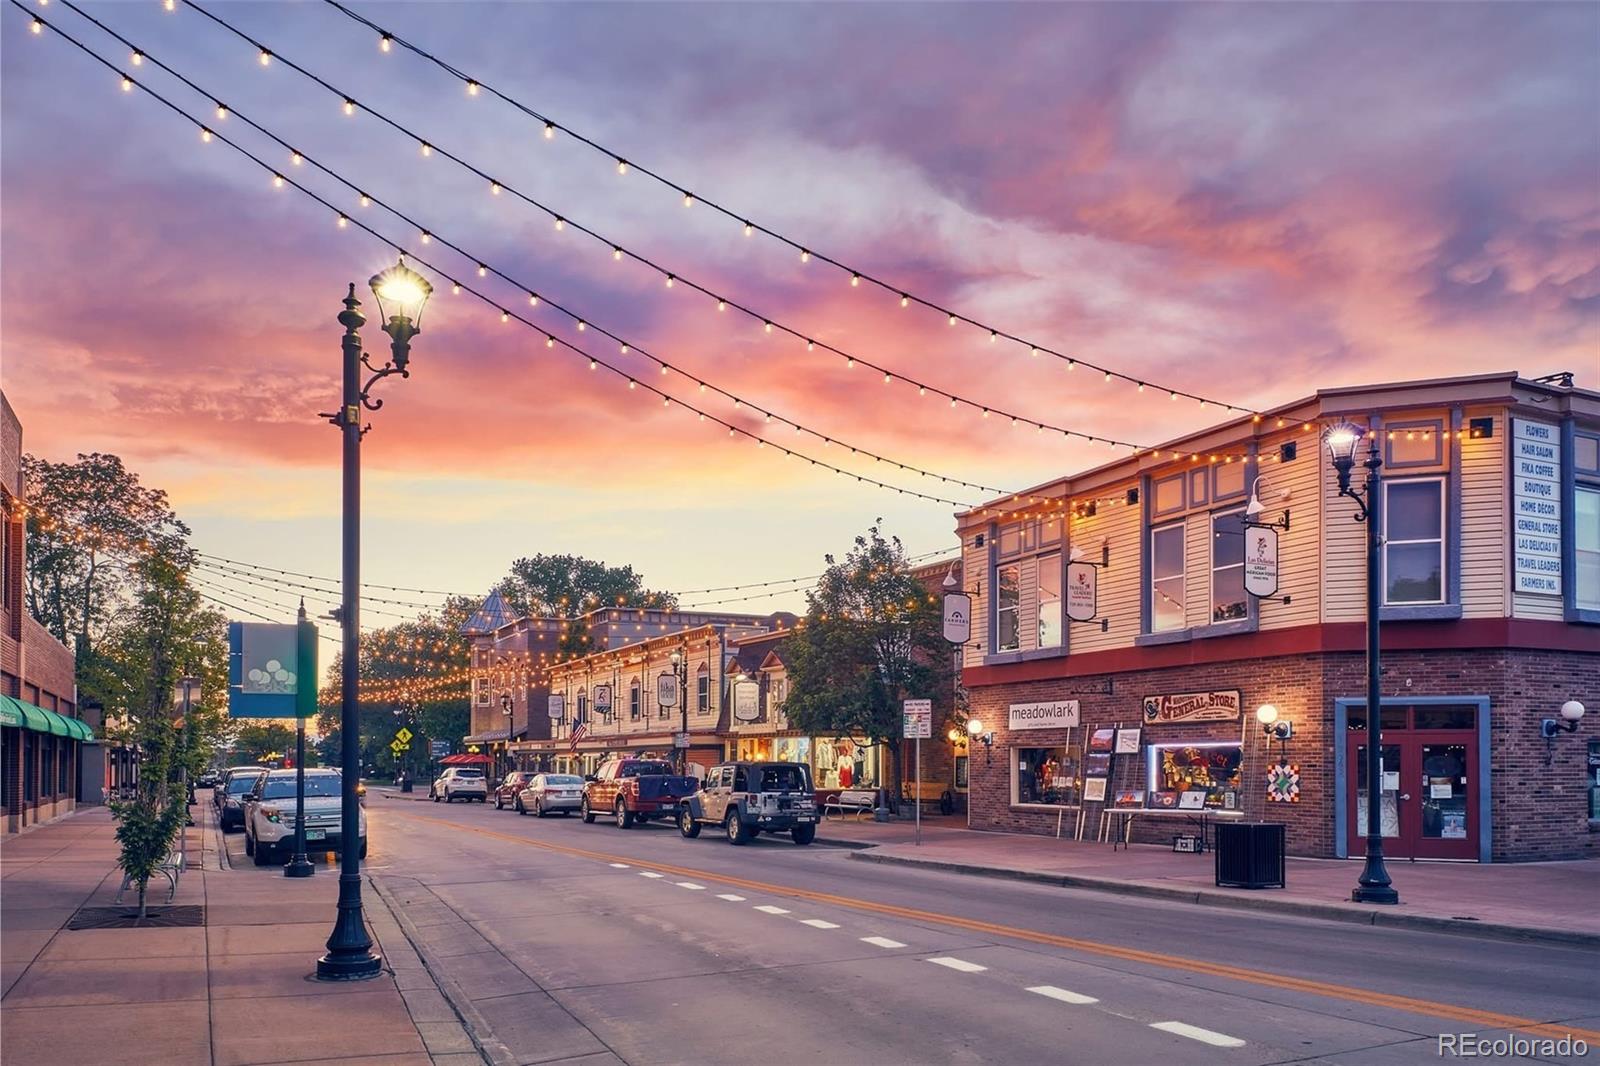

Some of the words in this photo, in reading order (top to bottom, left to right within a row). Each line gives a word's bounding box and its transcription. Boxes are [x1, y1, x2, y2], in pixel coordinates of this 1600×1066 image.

[1526, 425, 1549, 439] FLOWERS
[1521, 444, 1535, 456] HAIR
[1536, 446, 1553, 459] SALON
[1521, 462, 1534, 474] FIKA
[1535, 465, 1554, 477] COFFEE
[1524, 481, 1551, 497] BOUTIQUE
[1520, 500, 1536, 512] HOME
[1518, 519, 1541, 533] GENERAL
[1542, 521, 1558, 534] STORE
[1518, 538, 1528, 549] LAS
[1529, 540, 1551, 552] DELICIAS
[1517, 557, 1536, 569] TRAVEL
[1537, 558, 1560, 572] LEADERS
[1521, 576, 1545, 589] FARMERS
[1012, 702, 1074, 720] meadowlark
[1160, 695, 1206, 720] GENERAL
[1208, 692, 1235, 708] STORE
